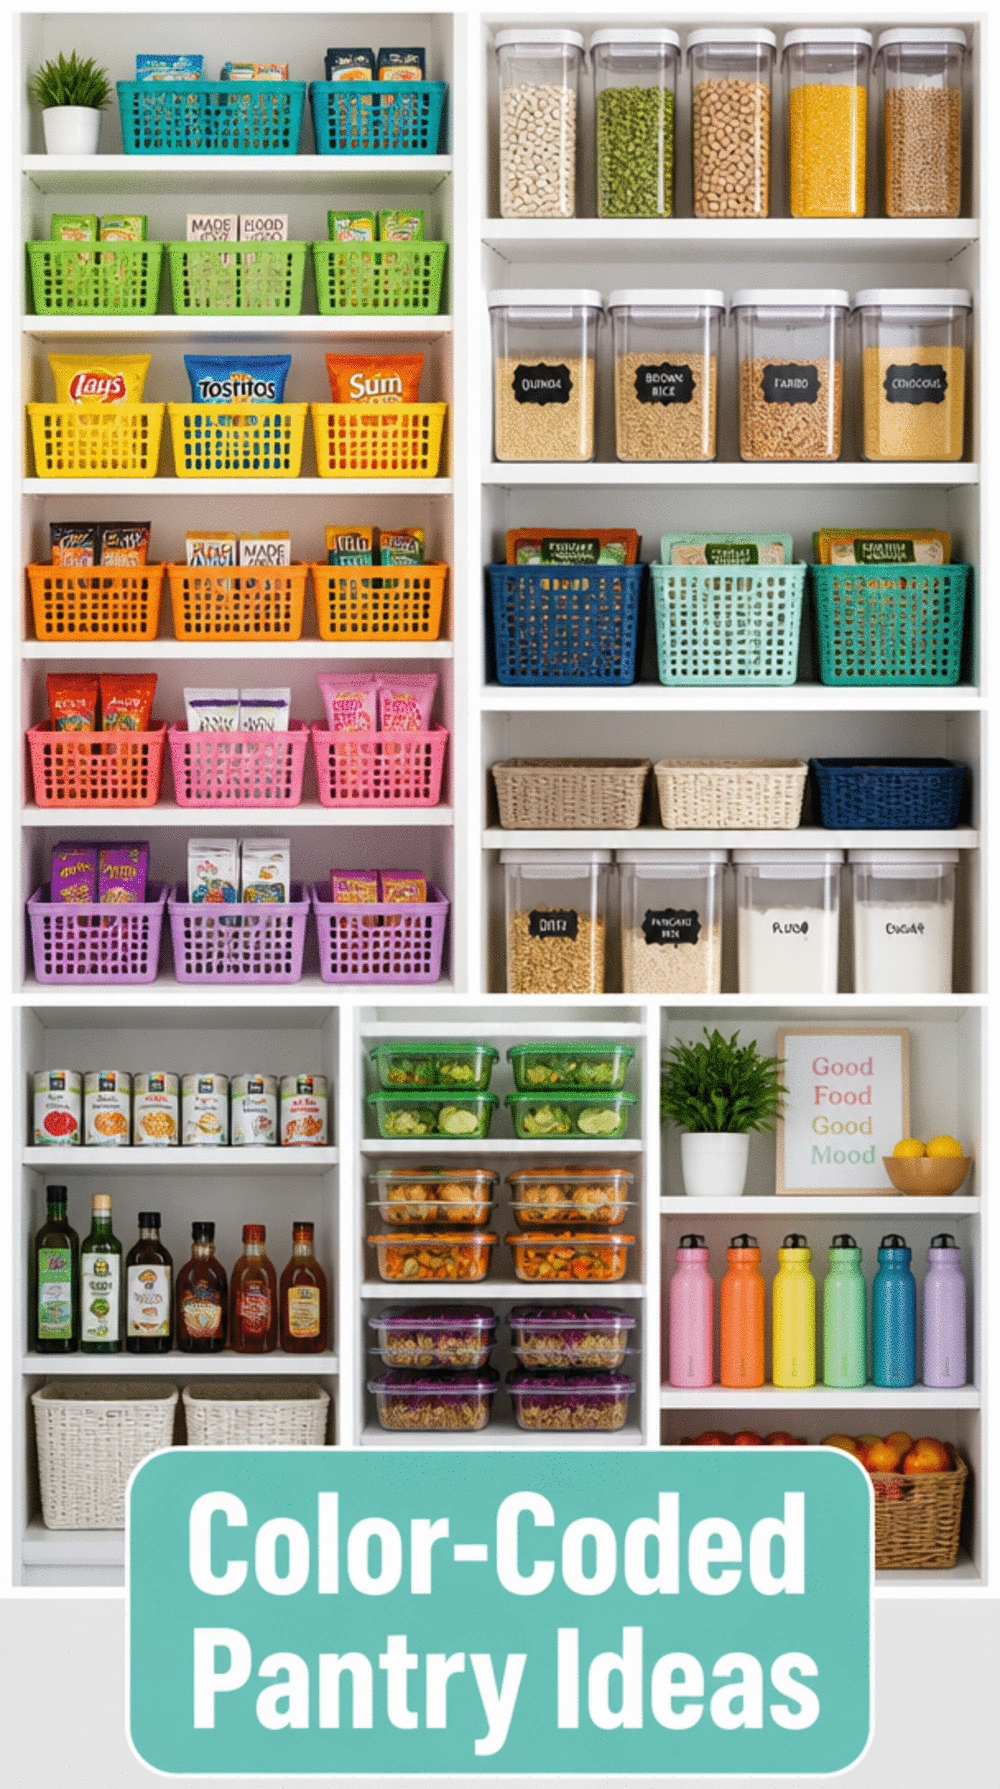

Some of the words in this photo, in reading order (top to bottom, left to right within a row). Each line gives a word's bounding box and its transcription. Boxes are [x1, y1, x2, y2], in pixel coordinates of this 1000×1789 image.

[811, 1056, 874, 1076] Good
[813, 1084, 873, 1106] Food
[811, 1115, 873, 1136] Good
[810, 1144, 877, 1165] Mood
